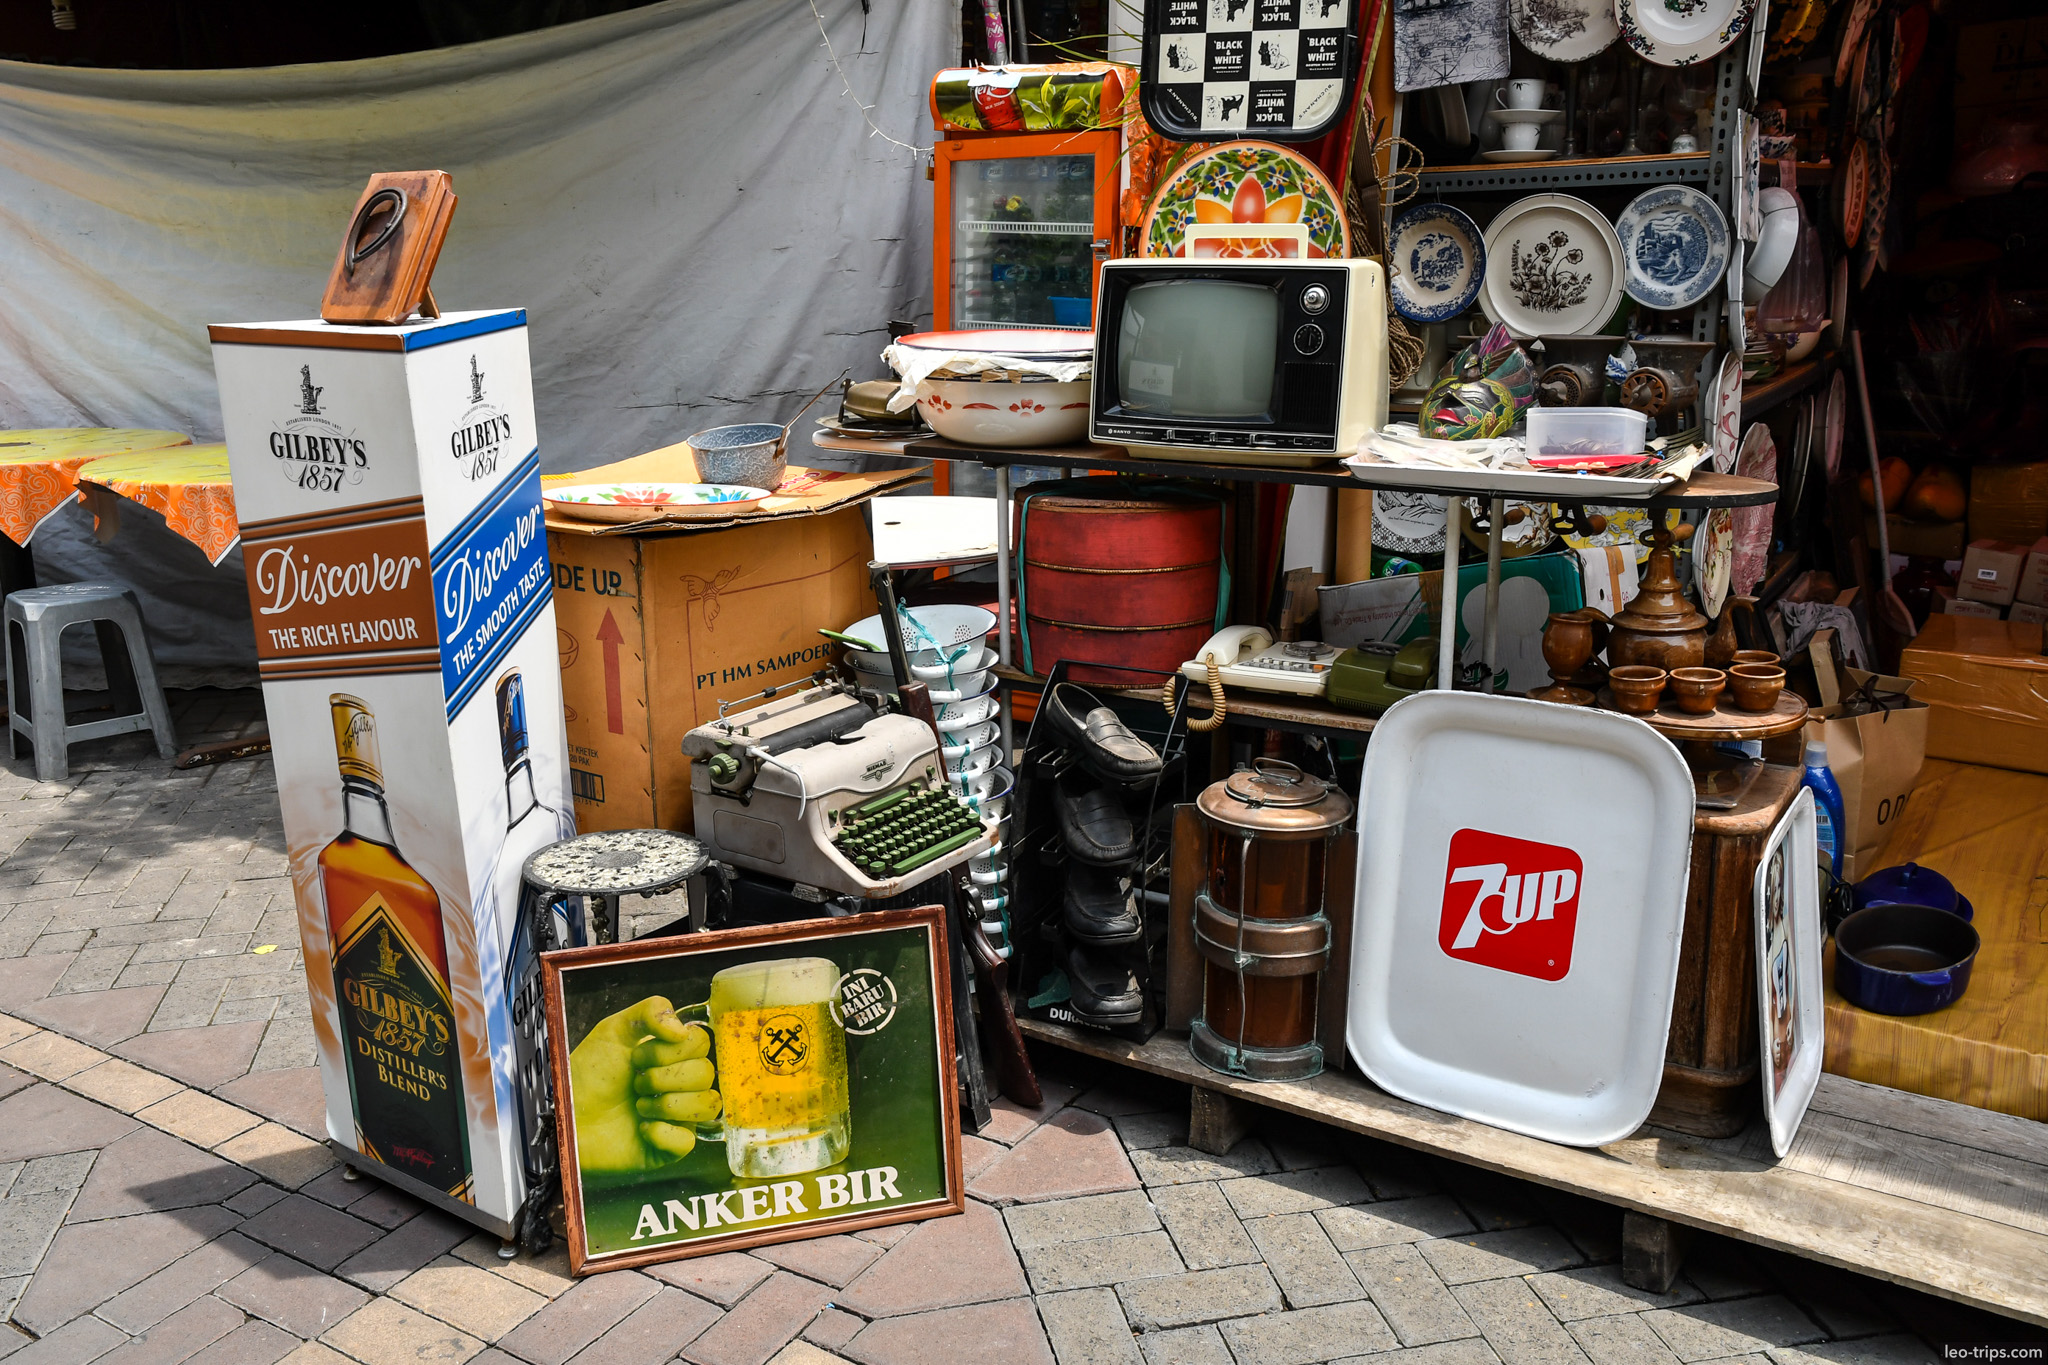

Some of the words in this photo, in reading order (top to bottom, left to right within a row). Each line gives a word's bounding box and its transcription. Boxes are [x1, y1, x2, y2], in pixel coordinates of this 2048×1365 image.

[1214, 40, 1243, 50] 'BLACK
[1214, 54, 1244, 64] WHITE'
[1307, 37, 1337, 46] 'BLACK
[1308, 51, 1338, 62] WHITE'
[1256, 113, 1285, 122] 'BLACK
[270, 432, 367, 468] GILBEY'S
[451, 414, 511, 459] GILBEY'S
[298, 464, 344, 492] 1857
[471, 447, 499, 482] 1857
[256, 545, 422, 614] Discover
[444, 504, 540, 644] Discover
[269, 627, 300, 649] THE
[301, 624, 339, 647] RICH
[340, 617, 418, 644] FLAVOUR
[452, 637, 476, 676] THE
[476, 588, 520, 651] SMOOTH
[518, 556, 545, 599] TASTE
[697, 672, 717, 689] PT
[722, 664, 752, 683] HM
[1449, 862, 1577, 950] 7UP
[840, 984, 884, 1018] BARU
[842, 976, 870, 1000] INI
[344, 978, 450, 1044] GILBEY'S
[854, 1002, 886, 1028] BIR
[374, 1020, 426, 1056] 1857
[358, 1036, 447, 1090] DISTILLER'S
[378, 1063, 431, 1102] BLEND
[630, 1180, 808, 1240] ANKER
[815, 1166, 903, 1210] BIR
